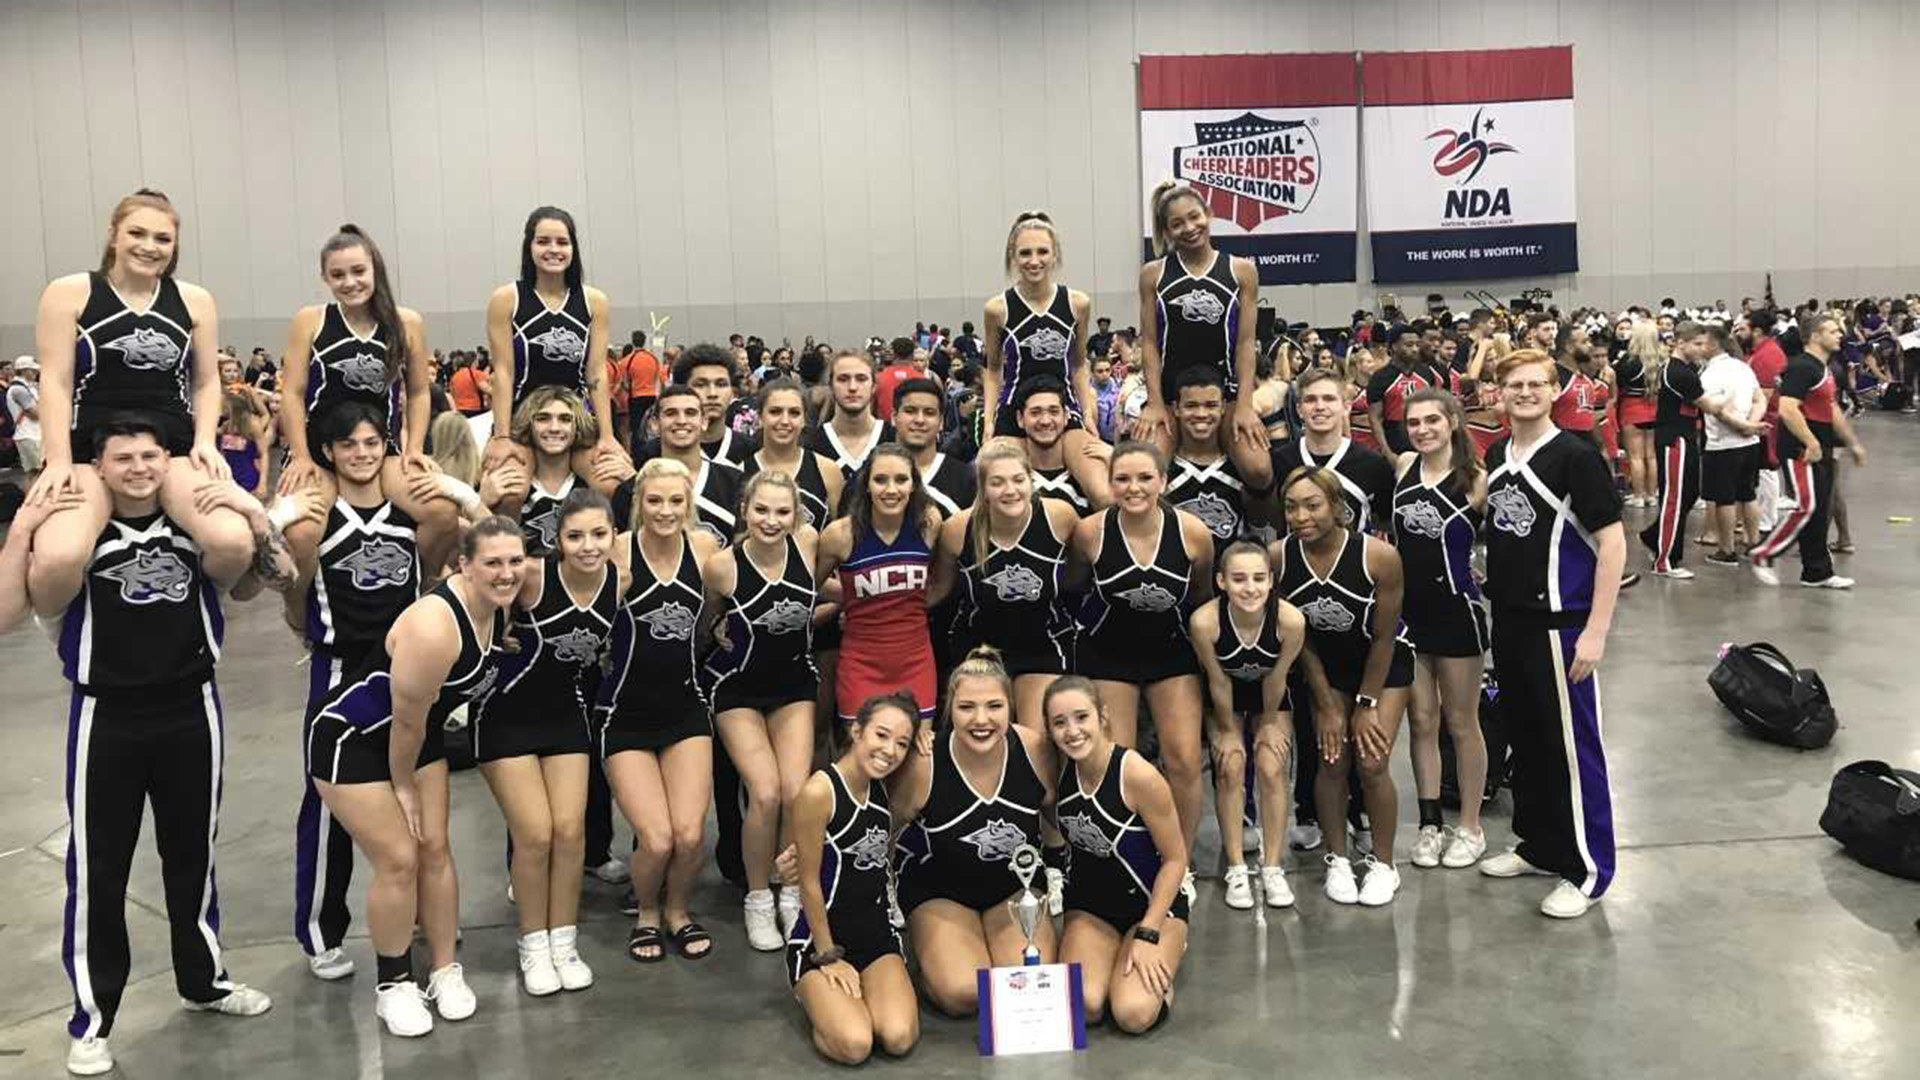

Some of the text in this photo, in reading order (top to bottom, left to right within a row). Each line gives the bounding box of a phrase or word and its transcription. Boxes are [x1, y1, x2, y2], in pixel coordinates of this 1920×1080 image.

[1207, 135, 1295, 156] NATIONAL
[1183, 156, 1315, 185] CHEERLEADERS
[1199, 172, 1296, 204] ASSOCIATION
[1444, 188, 1511, 218] NDA
[1259, 253, 1301, 265] WORTH
[1406, 251, 1429, 261] THE
[1432, 249, 1467, 260] WORK
[1469, 248, 1481, 259] IS
[1483, 246, 1523, 258] WORTH
[854, 564, 927, 598] NCA
